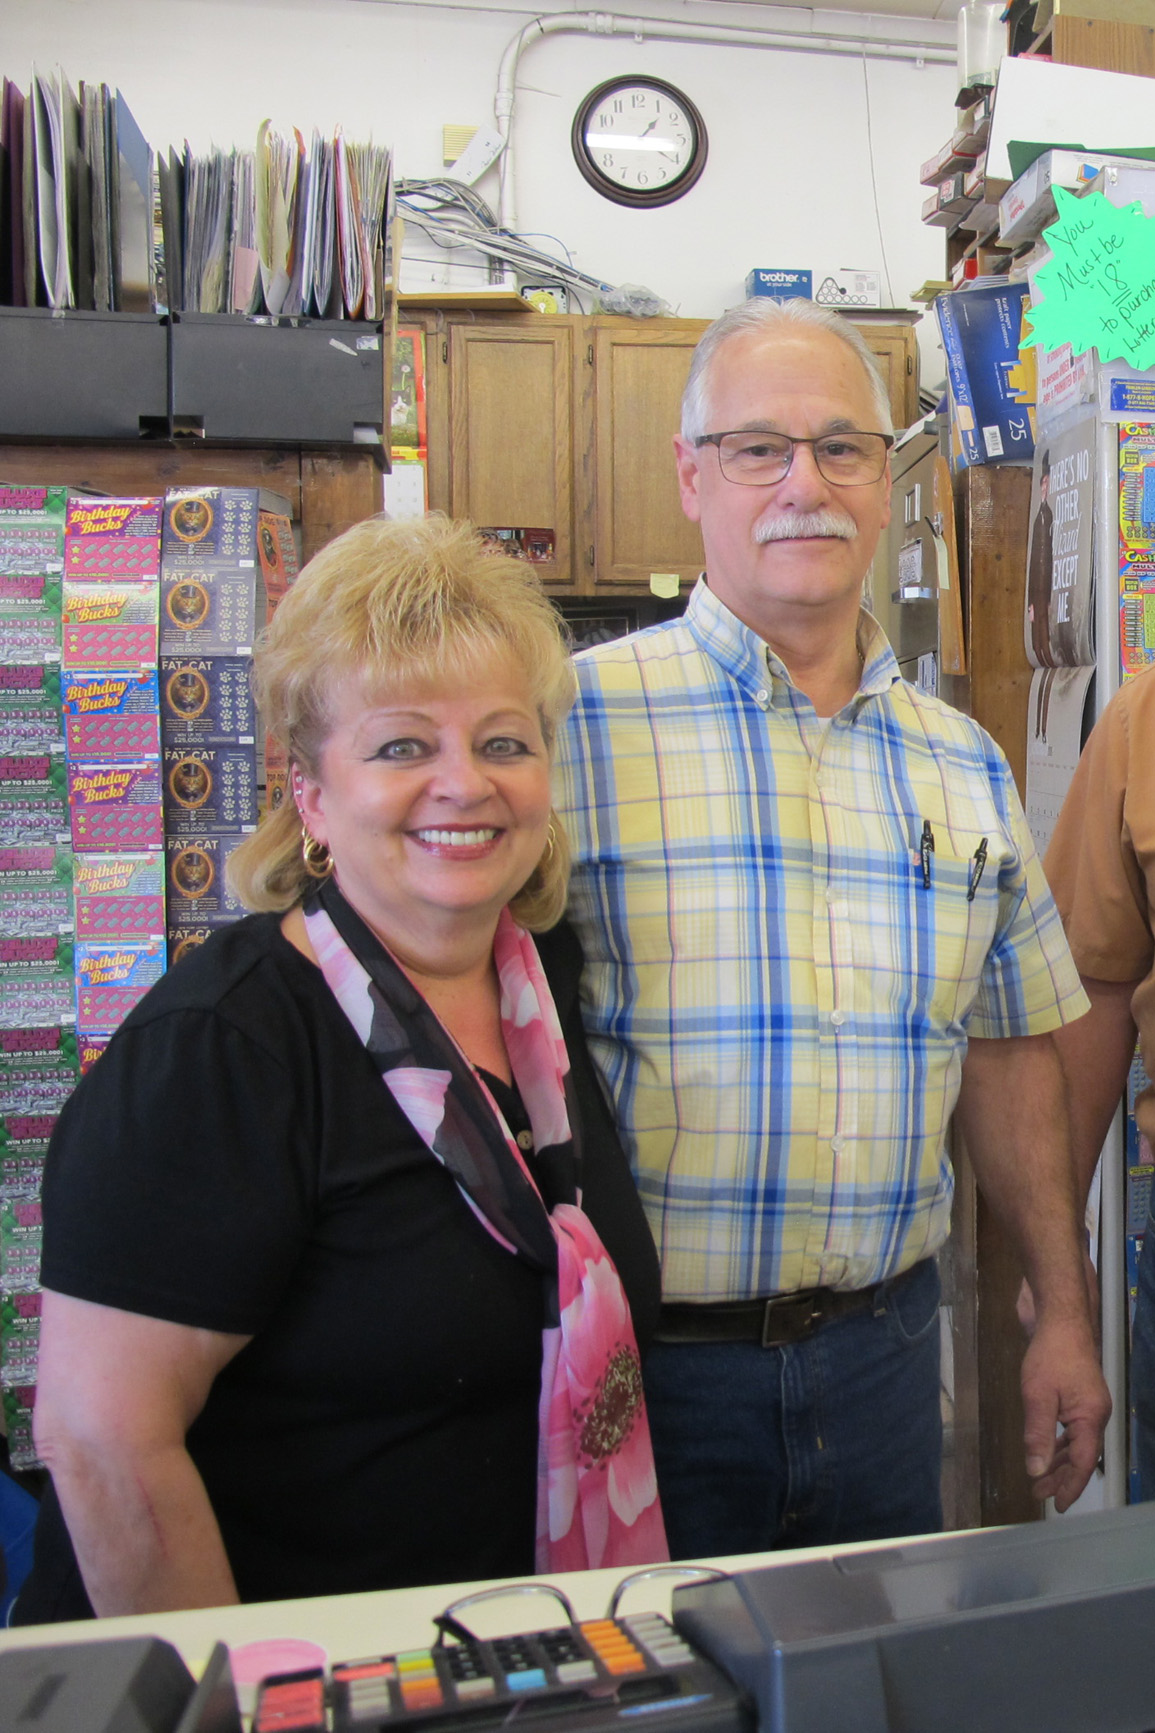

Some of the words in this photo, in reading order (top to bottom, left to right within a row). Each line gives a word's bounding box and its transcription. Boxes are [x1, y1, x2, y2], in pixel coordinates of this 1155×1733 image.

[614, 100, 622, 113] 11
[632, 94, 645, 108] 12
[656, 100, 660, 113] 1
[600, 114, 614, 128] 10
[669, 113, 679, 126] 2
[603, 153, 614, 167] 8
[620, 167, 628, 179] 7
[637, 171, 648, 185] 6
[659, 167, 666, 179] 5
[1046, 220, 1094, 256] You
[1057, 249, 1101, 301] Must
[1099, 234, 1124, 255] be
[760, 272, 798, 283] brother
[1100, 315, 1118, 334] to
[1009, 418, 1027, 441] 25
[969, 448, 979, 461] 25
[1050, 455, 1075, 495] THERE'S
[1077, 449, 1089, 483] NO
[192, 491, 220, 499] CAT
[1055, 488, 1079, 523] OTHER
[70, 506, 131, 523] Birthday
[81, 518, 123, 535] Bucks
[163, 573, 185, 582] FAT
[191, 574, 215, 582] CAT
[1053, 555, 1079, 591] EXCEPT
[67, 592, 129, 611] Birthday
[78, 605, 121, 623] Bucks
[162, 661, 183, 670] FAT
[189, 661, 213, 670] CAT
[66, 680, 128, 700] Birthday
[79, 696, 121, 713] Bucks
[165, 752, 186, 760] FAT
[191, 752, 216, 760] CAT
[73, 771, 132, 791] Birthday
[84, 786, 126, 803] Bucks
[168, 841, 189, 850] FAT
[195, 840, 218, 850] CAT
[76, 861, 135, 883] Birthday
[87, 878, 130, 895] Bucks
[169, 931, 189, 940] FAT
[196, 930, 215, 939] CA
[79, 953, 137, 974] Birthday
[90, 969, 130, 985] Bucks
